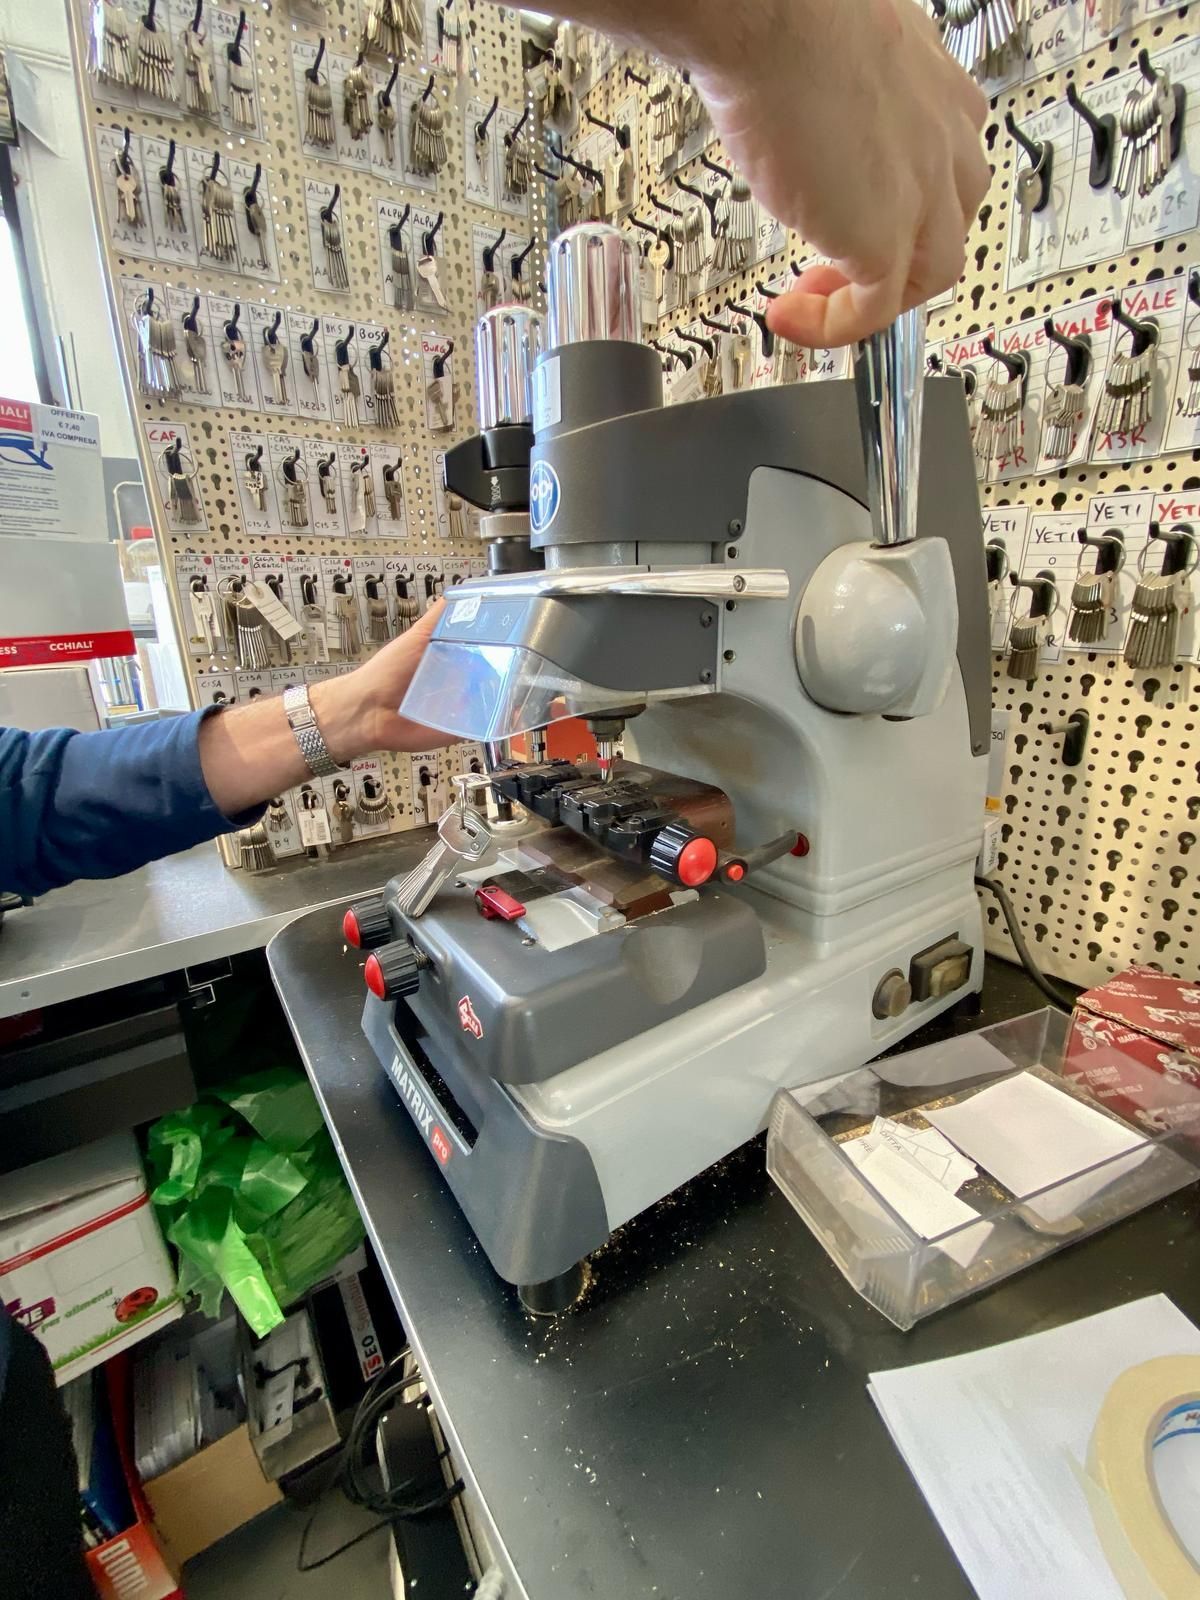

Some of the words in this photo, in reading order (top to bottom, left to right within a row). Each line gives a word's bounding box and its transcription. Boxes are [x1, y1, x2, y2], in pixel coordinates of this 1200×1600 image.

[1124, 288, 1178, 318] YALE
[1053, 315, 1113, 339] YALE
[1002, 328, 1046, 355] YALE
[50, 407, 86, 423] OFFERTA
[41, 429, 56, 440] IVA
[56, 431, 98, 447] COMPRESA
[1093, 501, 1142, 524] YETI
[1035, 526, 1075, 545] YETI
[386, 562, 408, 575] CISA
[417, 562, 438, 574] CISA
[238, 674, 262, 684] CISA
[391, 1055, 435, 1137] MATRIX
[432, 1132, 449, 1160] pro
